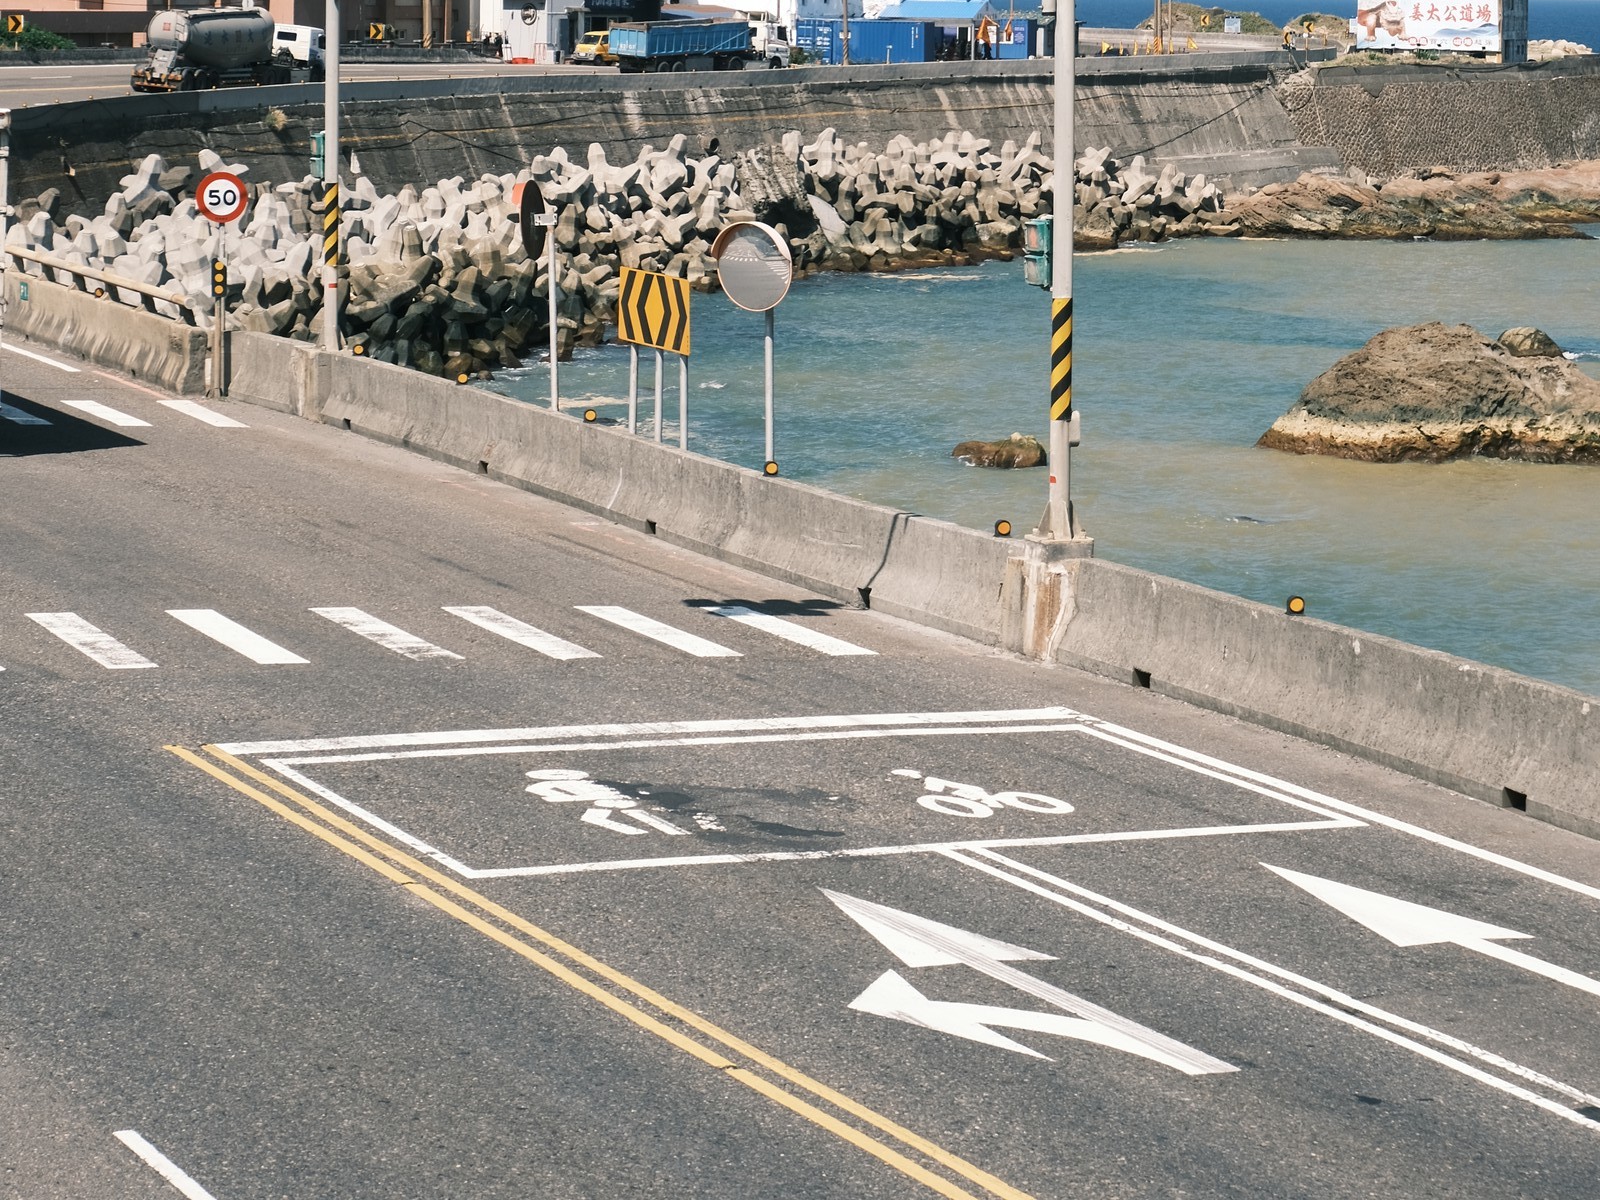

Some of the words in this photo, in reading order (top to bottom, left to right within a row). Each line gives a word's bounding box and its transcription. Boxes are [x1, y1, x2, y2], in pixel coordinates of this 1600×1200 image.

[1409, 3, 1492, 23] 姜太公道場
[208, 189, 236, 206] 50
